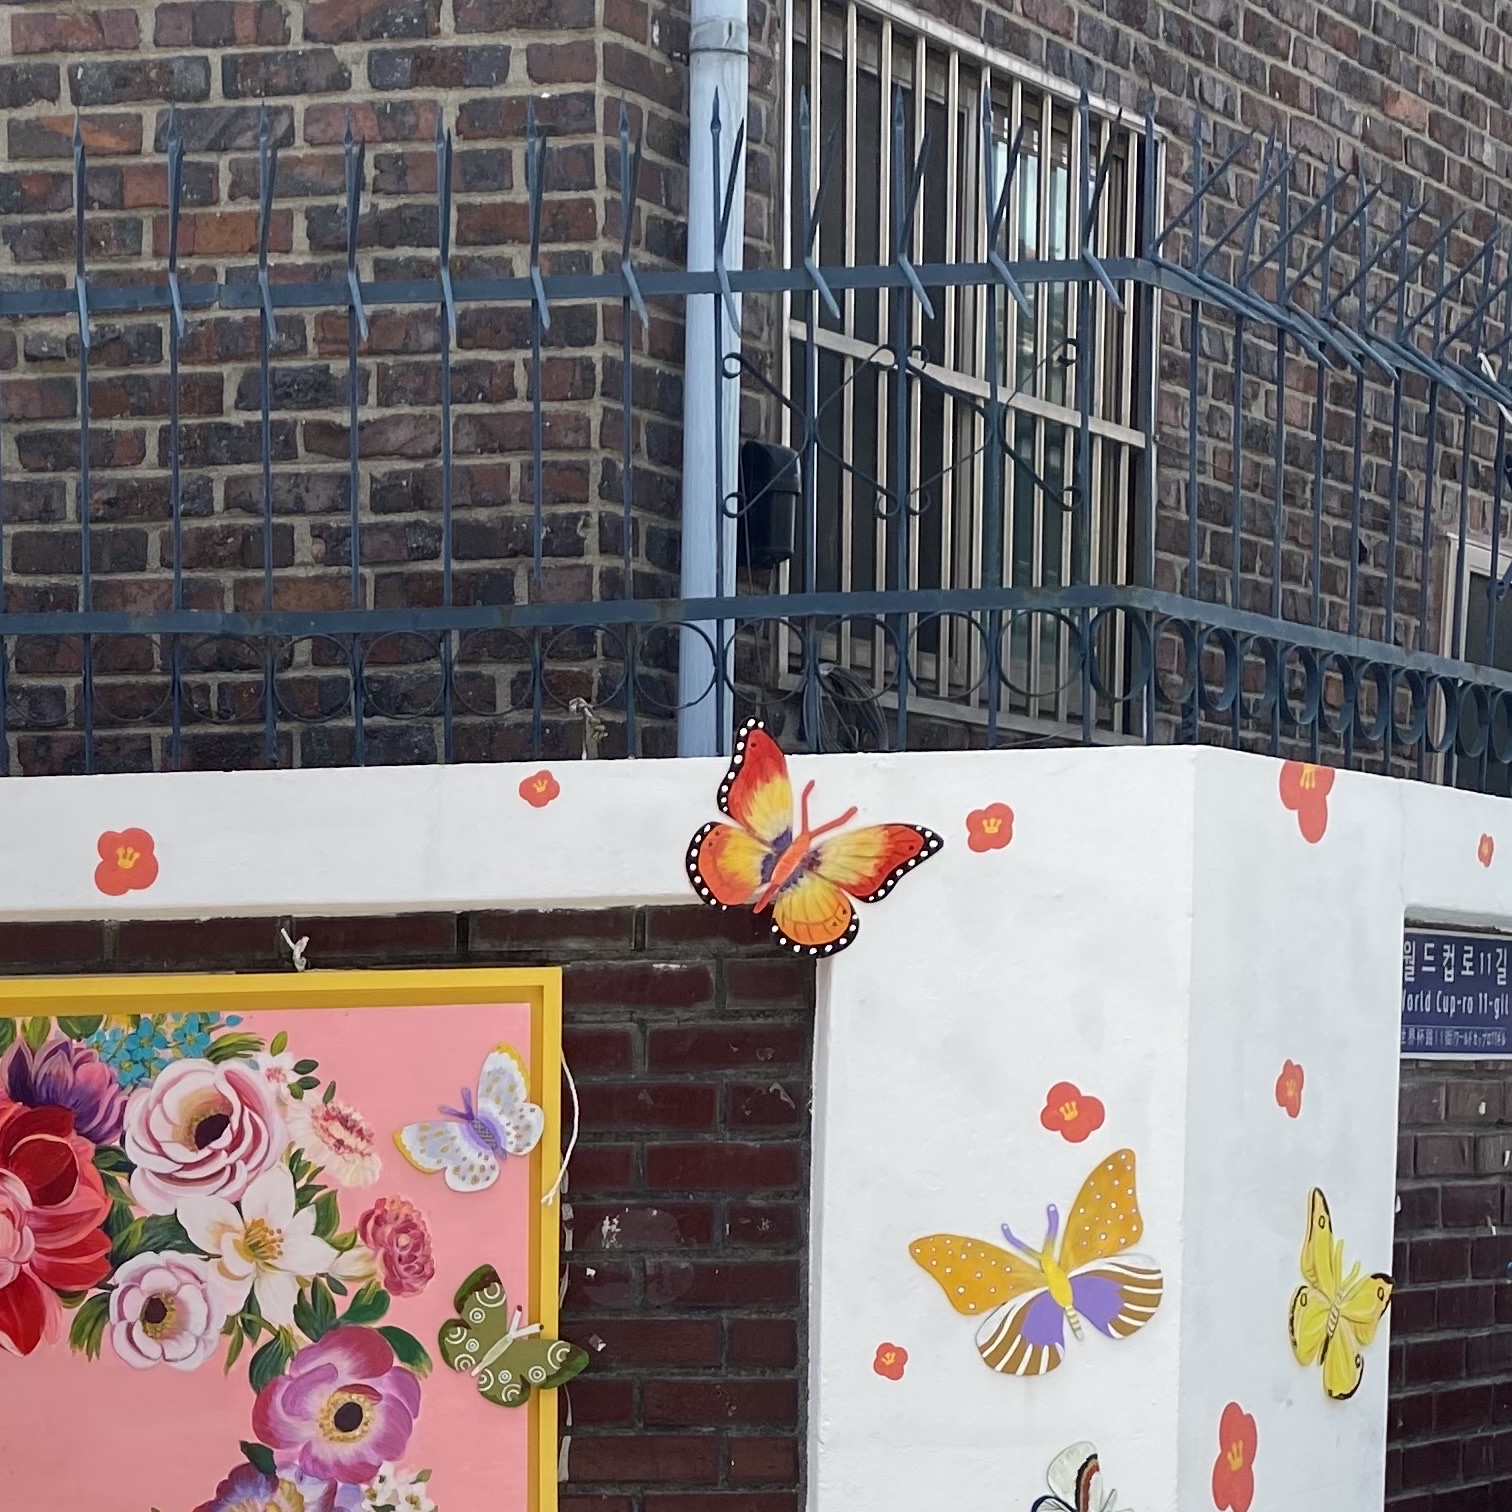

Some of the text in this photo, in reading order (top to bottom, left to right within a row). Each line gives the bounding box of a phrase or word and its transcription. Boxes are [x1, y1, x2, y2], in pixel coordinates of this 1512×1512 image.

[1403, 940, 1508, 985] 월드컵로11길
[1436, 990, 1474, 1018] Cup-ro
[1478, 992, 1509, 1020] 11-gil
